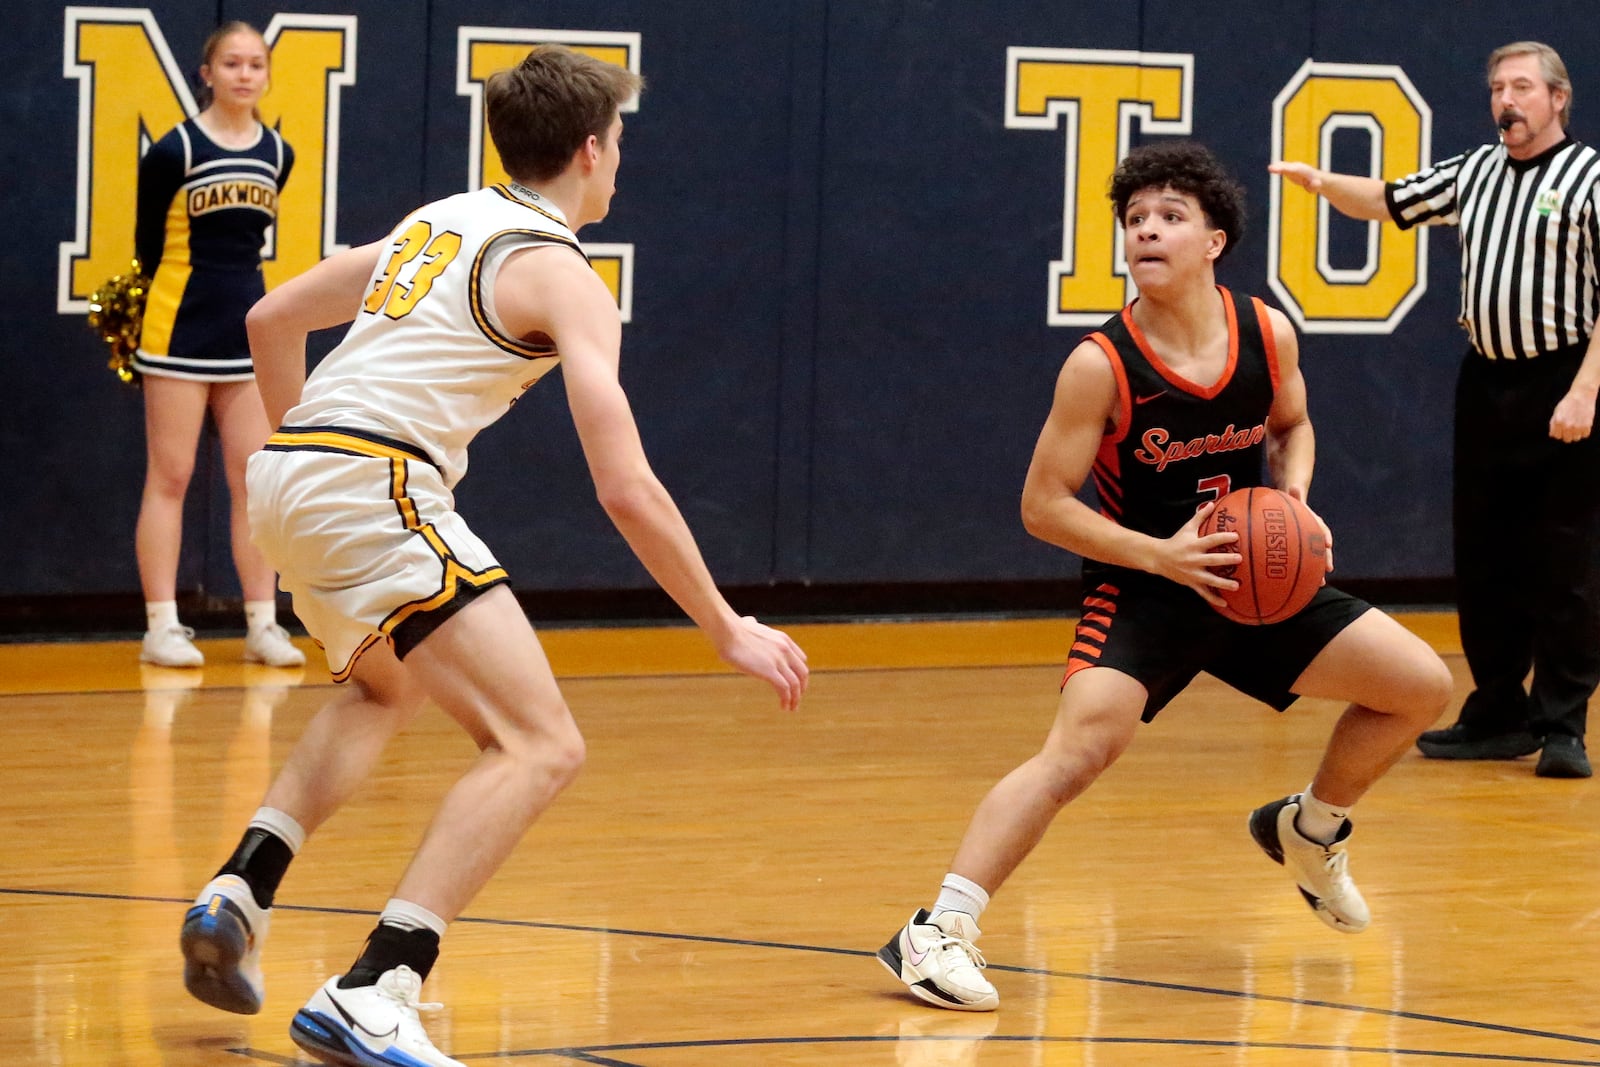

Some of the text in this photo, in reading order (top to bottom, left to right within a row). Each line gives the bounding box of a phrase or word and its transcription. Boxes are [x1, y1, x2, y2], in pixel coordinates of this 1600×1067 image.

[193, 184, 277, 213] OAKWOO
[1005, 46, 1432, 335] TO
[363, 220, 463, 321] 33
[1263, 508, 1288, 580] OHSAA
